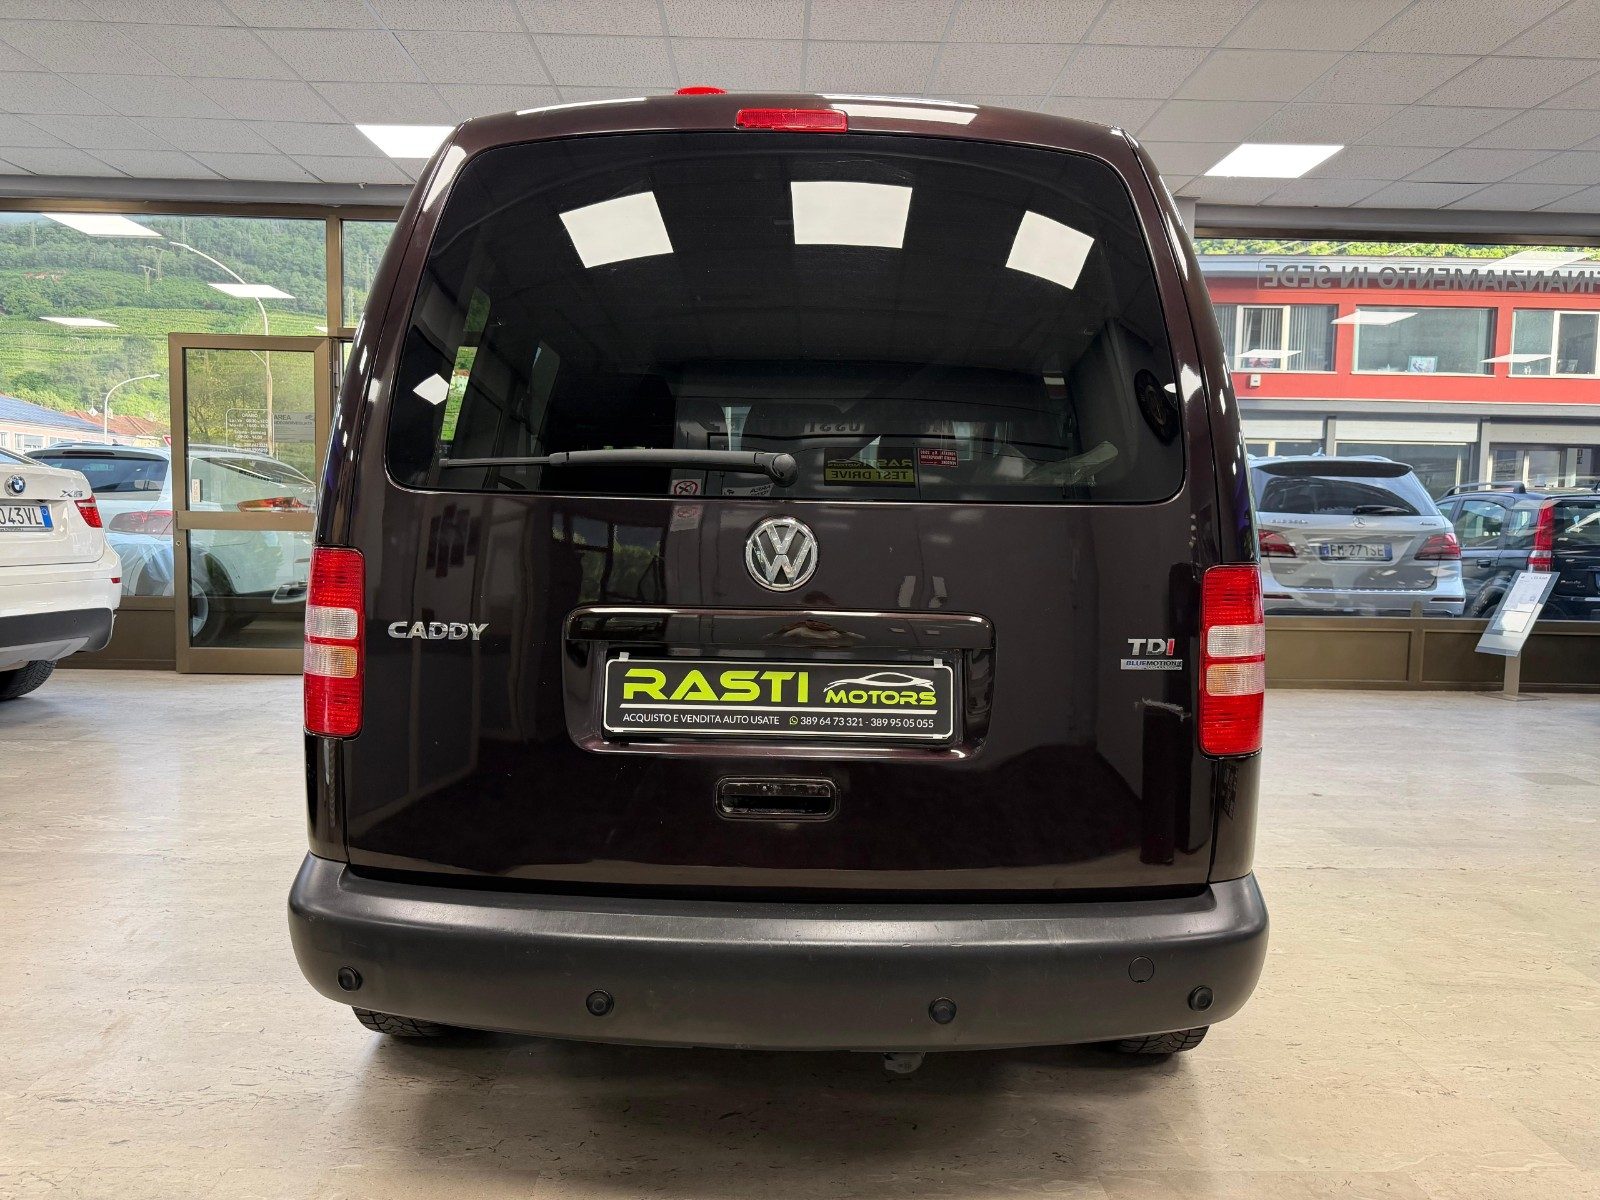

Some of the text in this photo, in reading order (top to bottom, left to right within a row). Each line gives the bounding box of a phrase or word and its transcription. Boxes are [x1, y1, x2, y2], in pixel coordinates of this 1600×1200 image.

[387, 621, 489, 640] CADDY
[1127, 638, 1175, 656] TDI
[623, 668, 937, 706] RASTI MOTORS
[623, 713, 671, 723] ACQUISTO
[673, 714, 679, 722] E
[680, 714, 722, 723] VENDITA
[723, 715, 749, 724] AUTO
[750, 716, 780, 725] USATE
[800, 716, 818, 726] 389
[819, 717, 831, 726] 64
[833, 717, 845, 726] 73
[846, 717, 863, 727] 321
[870, 718, 888, 727] 389
[889, 718, 901, 727] 95
[903, 718, 915, 728] 05
[916, 718, 934, 728] 055
